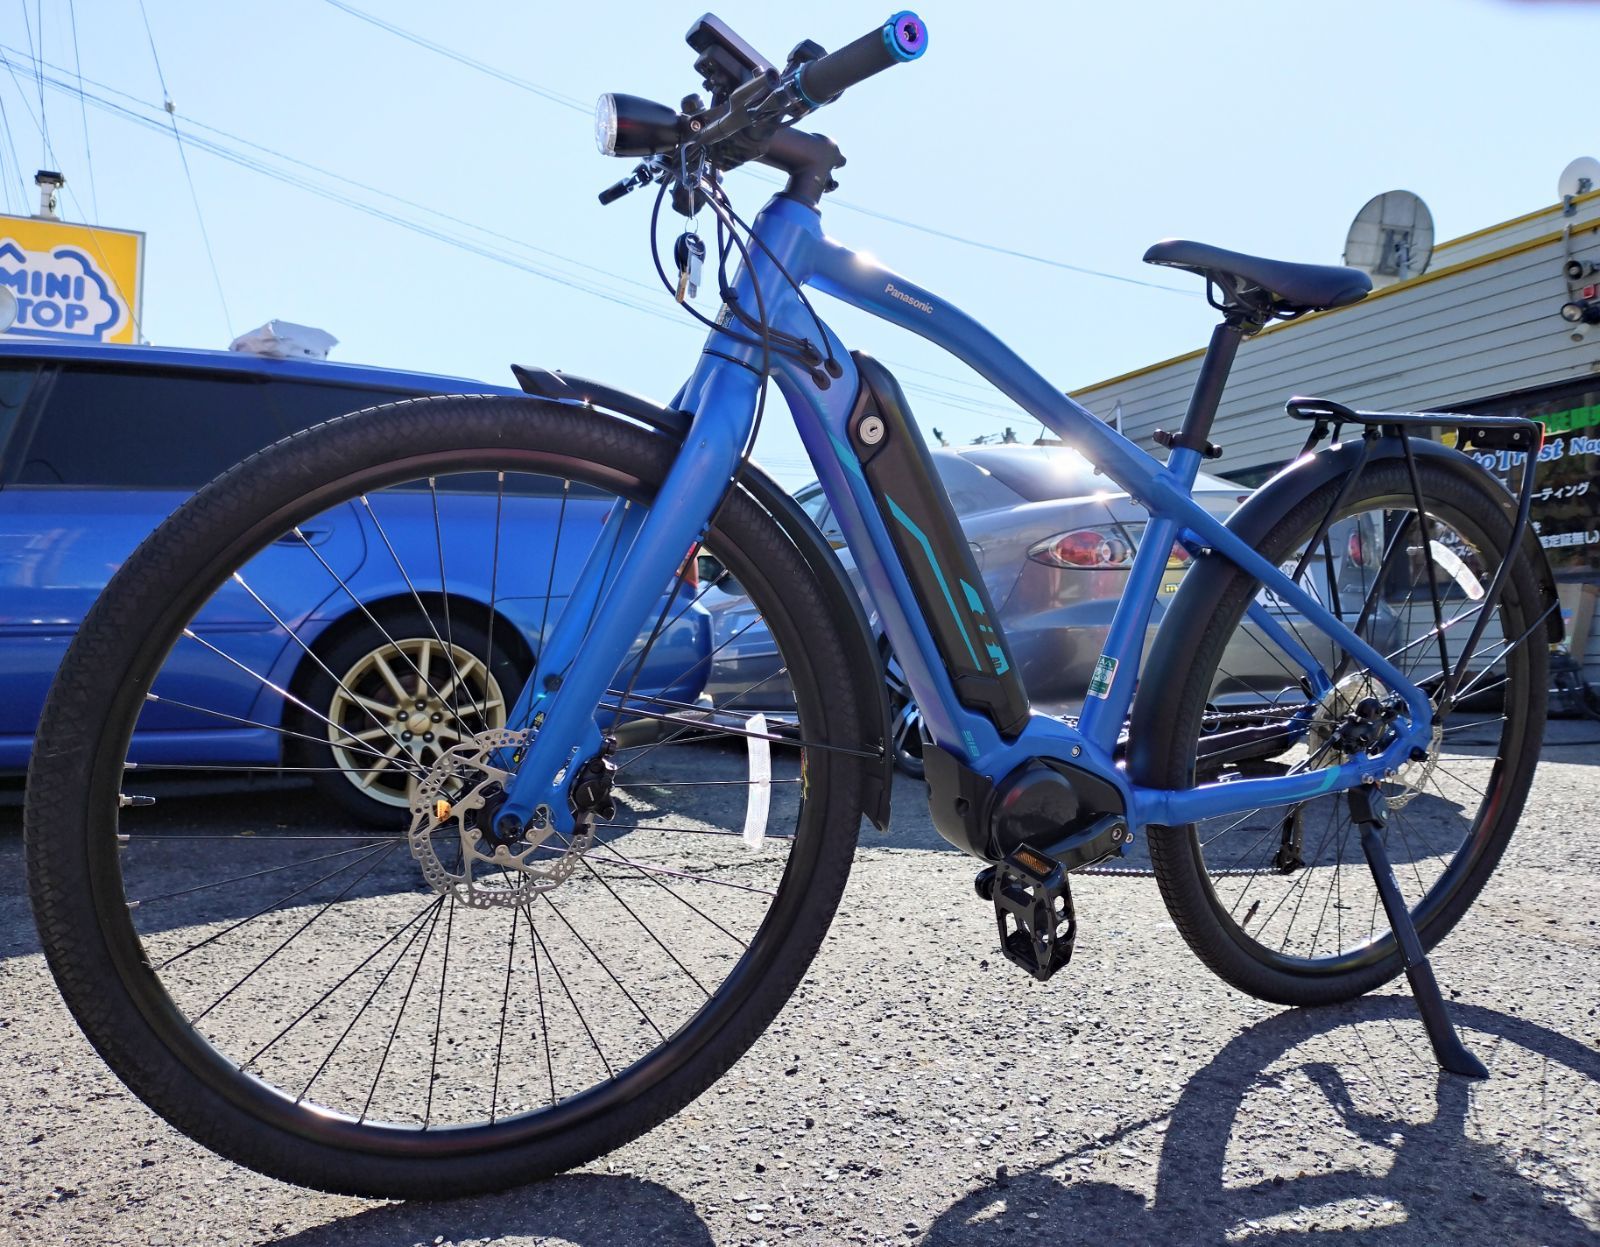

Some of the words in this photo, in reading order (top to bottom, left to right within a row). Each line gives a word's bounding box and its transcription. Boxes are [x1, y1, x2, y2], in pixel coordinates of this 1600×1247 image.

[0, 267, 85, 301] MINI
[884, 283, 934, 314] Panasonic
[16, 297, 89, 329] TOP
[1530, 481, 1591, 501] ーティング
